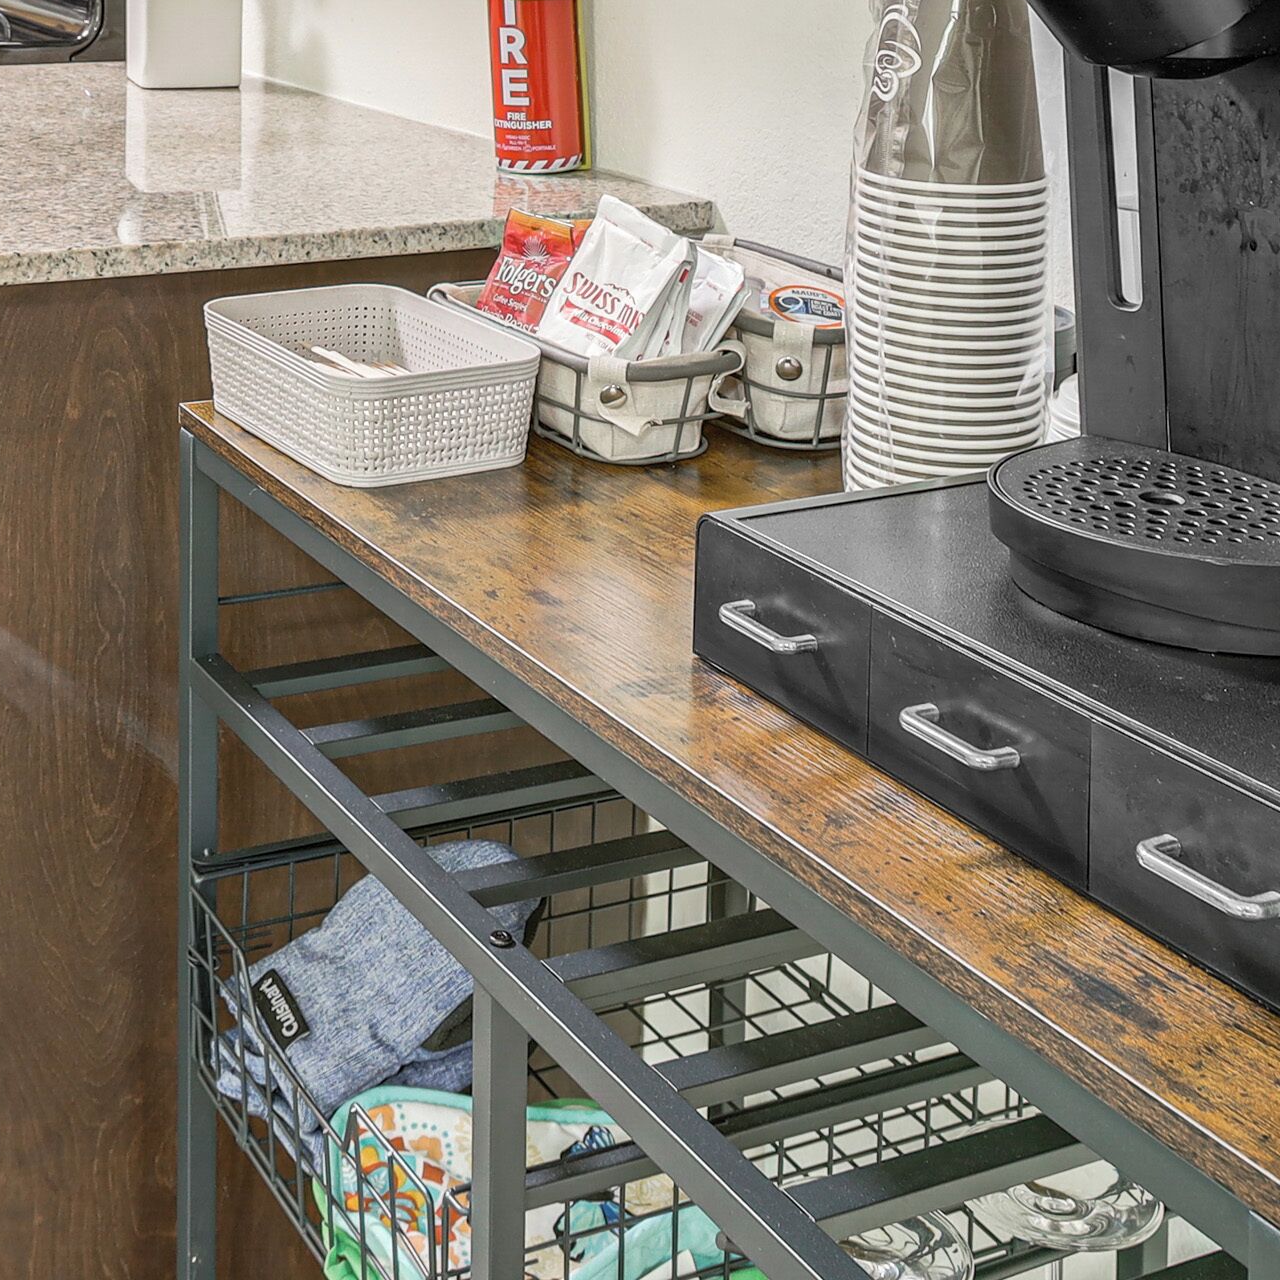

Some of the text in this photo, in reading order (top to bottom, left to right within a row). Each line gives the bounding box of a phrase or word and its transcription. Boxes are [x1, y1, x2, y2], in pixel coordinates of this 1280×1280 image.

[506, 111, 527, 121] FIRE
[495, 256, 557, 298] Folgers
[563, 272, 621, 315] SWISS
[258, 977, 300, 1038] Cuisinart
